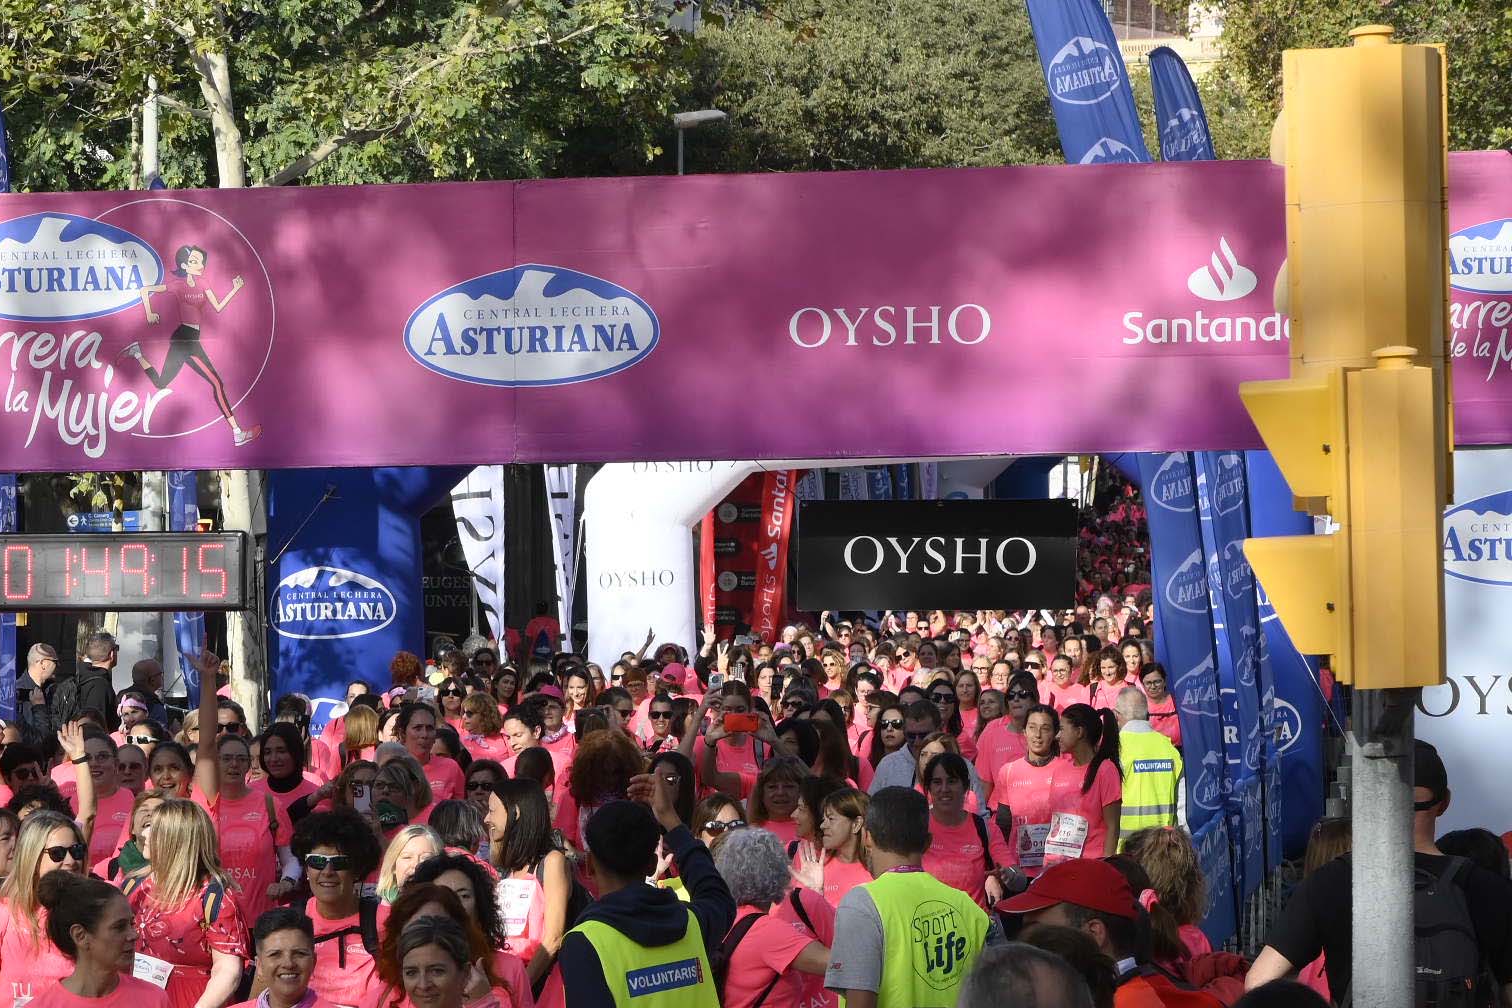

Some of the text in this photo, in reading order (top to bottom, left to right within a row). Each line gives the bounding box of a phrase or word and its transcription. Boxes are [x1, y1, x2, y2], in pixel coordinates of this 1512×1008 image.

[463, 304, 631, 321] CENTRAL LECHERA
[788, 303, 992, 349] OYSHO
[423, 311, 640, 357] ASTURIANA
[4, 374, 30, 413] la
[24, 364, 174, 459] Mujer
[4, 543, 227, 599] 01:49:15
[843, 534, 1038, 576] OYSHO
[274, 596, 387, 623] ASTURIANA
[913, 908, 957, 943] Sport
[923, 931, 967, 974] Life
[628, 966, 697, 991] VOLUNTARIS
